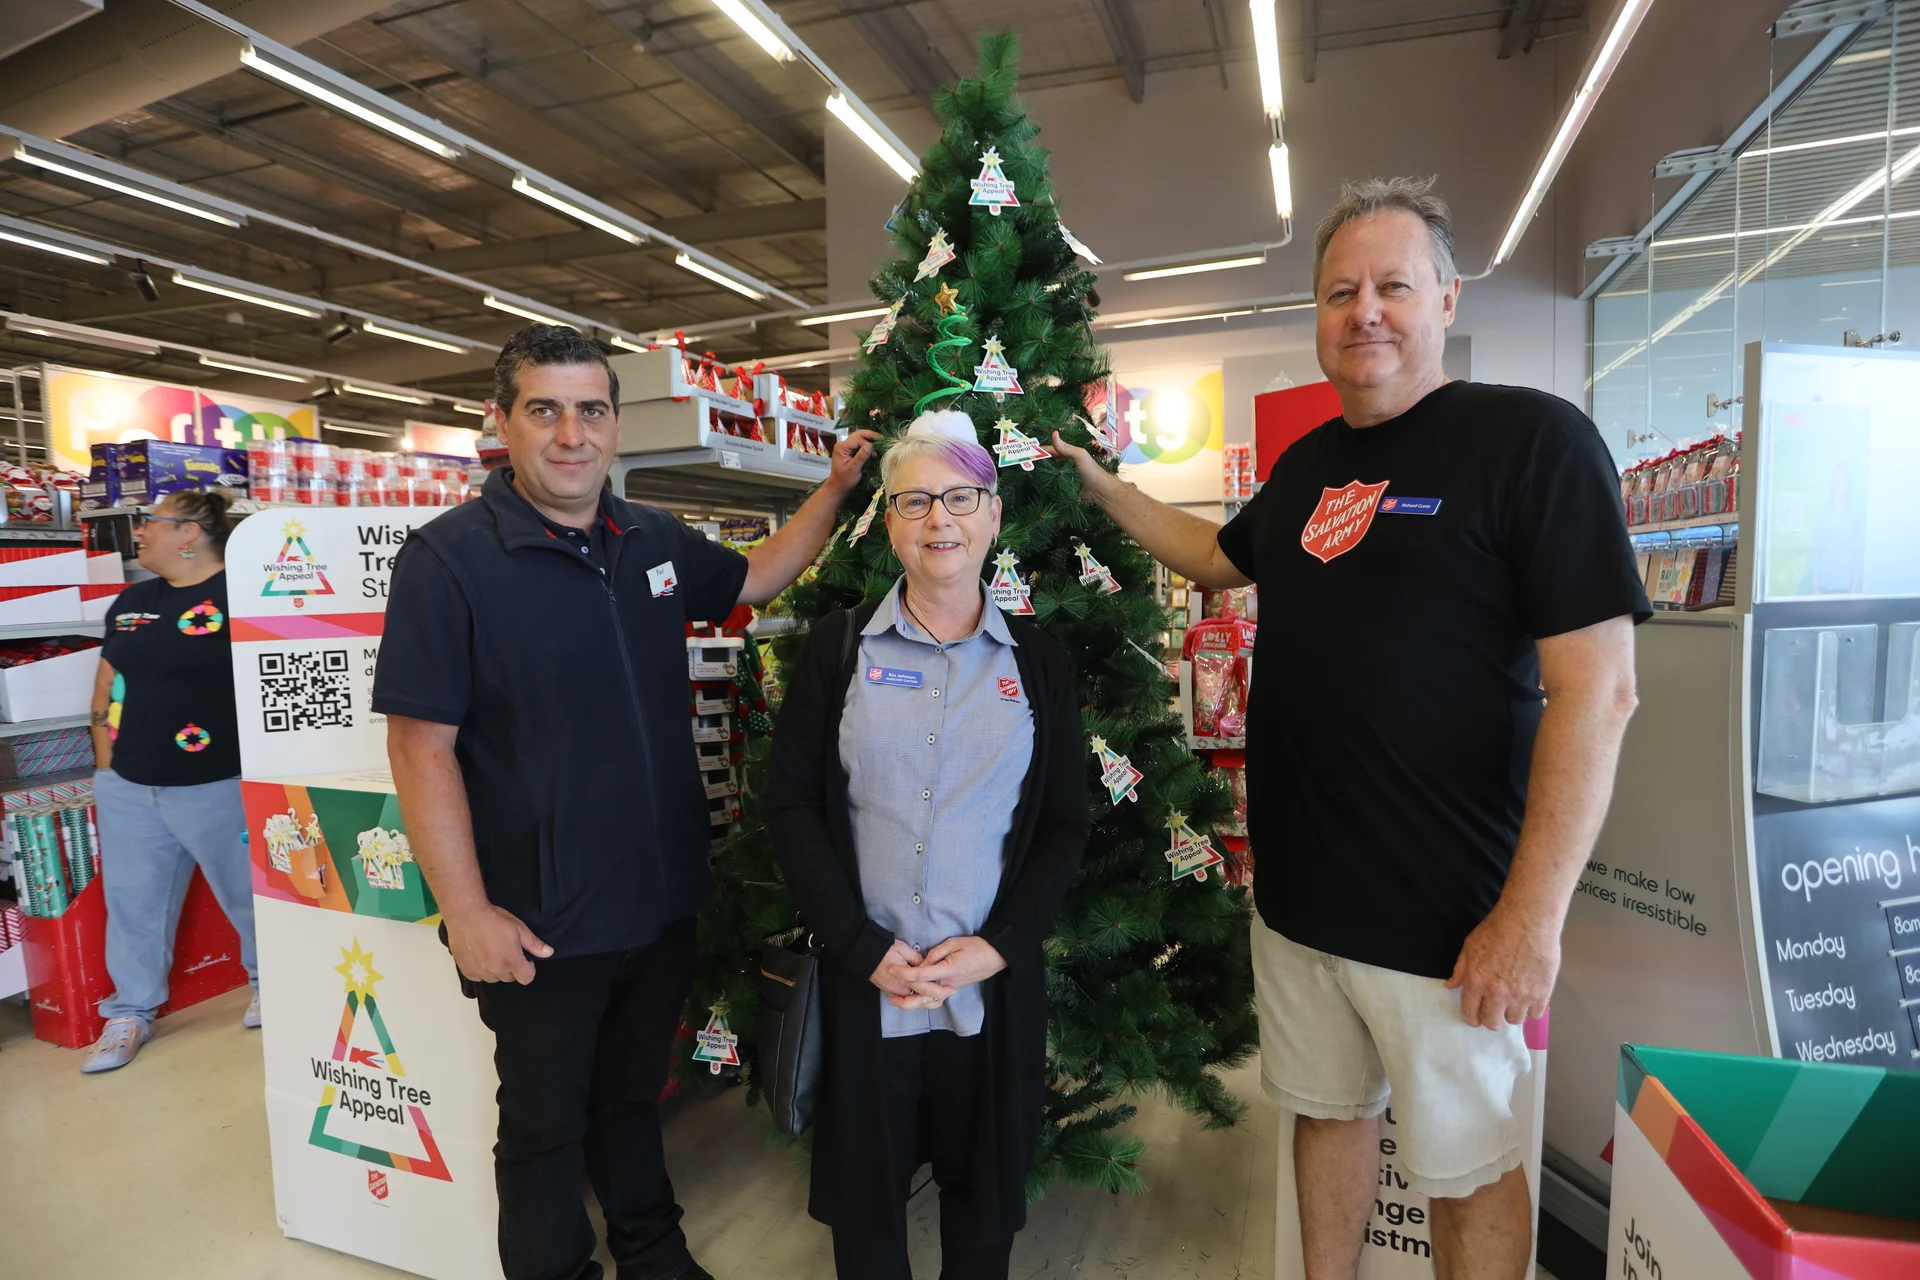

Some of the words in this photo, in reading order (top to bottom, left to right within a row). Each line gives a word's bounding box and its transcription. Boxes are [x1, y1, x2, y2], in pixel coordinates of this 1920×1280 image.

[972, 181, 998, 189] Wishing
[975, 368, 1001, 376] Wishing
[986, 374, 1008, 382] Appeal
[995, 443, 1022, 452] Wishing
[1007, 446, 1031, 455] Appeal
[1325, 489, 1356, 516] THE
[1304, 490, 1378, 542] SALVATION
[357, 524, 411, 546] Wis
[1321, 514, 1367, 552] ARMY
[263, 563, 303, 573] Wishing
[306, 563, 328, 571] Tree
[358, 551, 398, 571] Tre
[279, 572, 314, 581] Appeal
[989, 588, 1012, 596] ishing
[994, 595, 1019, 603] Appeal
[1202, 631, 1232, 643] LOLLY
[1103, 765, 1121, 784] Wishing
[1118, 758, 1130, 769] Tree
[1112, 770, 1128, 784] Appeal
[1167, 845, 1194, 860] Wishing
[1193, 838, 1209, 848] Tree
[1179, 848, 1203, 862] Appeal
[1781, 846, 1901, 902] opening
[1904, 834, 1920, 874] h
[1587, 860, 1608, 875] we
[1614, 870, 1658, 893] make
[1665, 879, 1695, 905] low
[1622, 893, 1707, 936] irresistible
[1776, 932, 1846, 962] Monday
[1785, 983, 1856, 1013] Tuesday
[699, 1034, 722, 1043] Wishing
[723, 1036, 736, 1044] Tree
[706, 1042, 727, 1050] Appeal
[1795, 1028, 1897, 1062] Wednesday
[310, 1057, 381, 1100] Wishing
[386, 1076, 432, 1106] Tree
[339, 1090, 405, 1125] Appeal
[1375, 1198, 1425, 1226] nge
[1364, 1221, 1430, 1258] istm
[1624, 1216, 1662, 1280] Join
